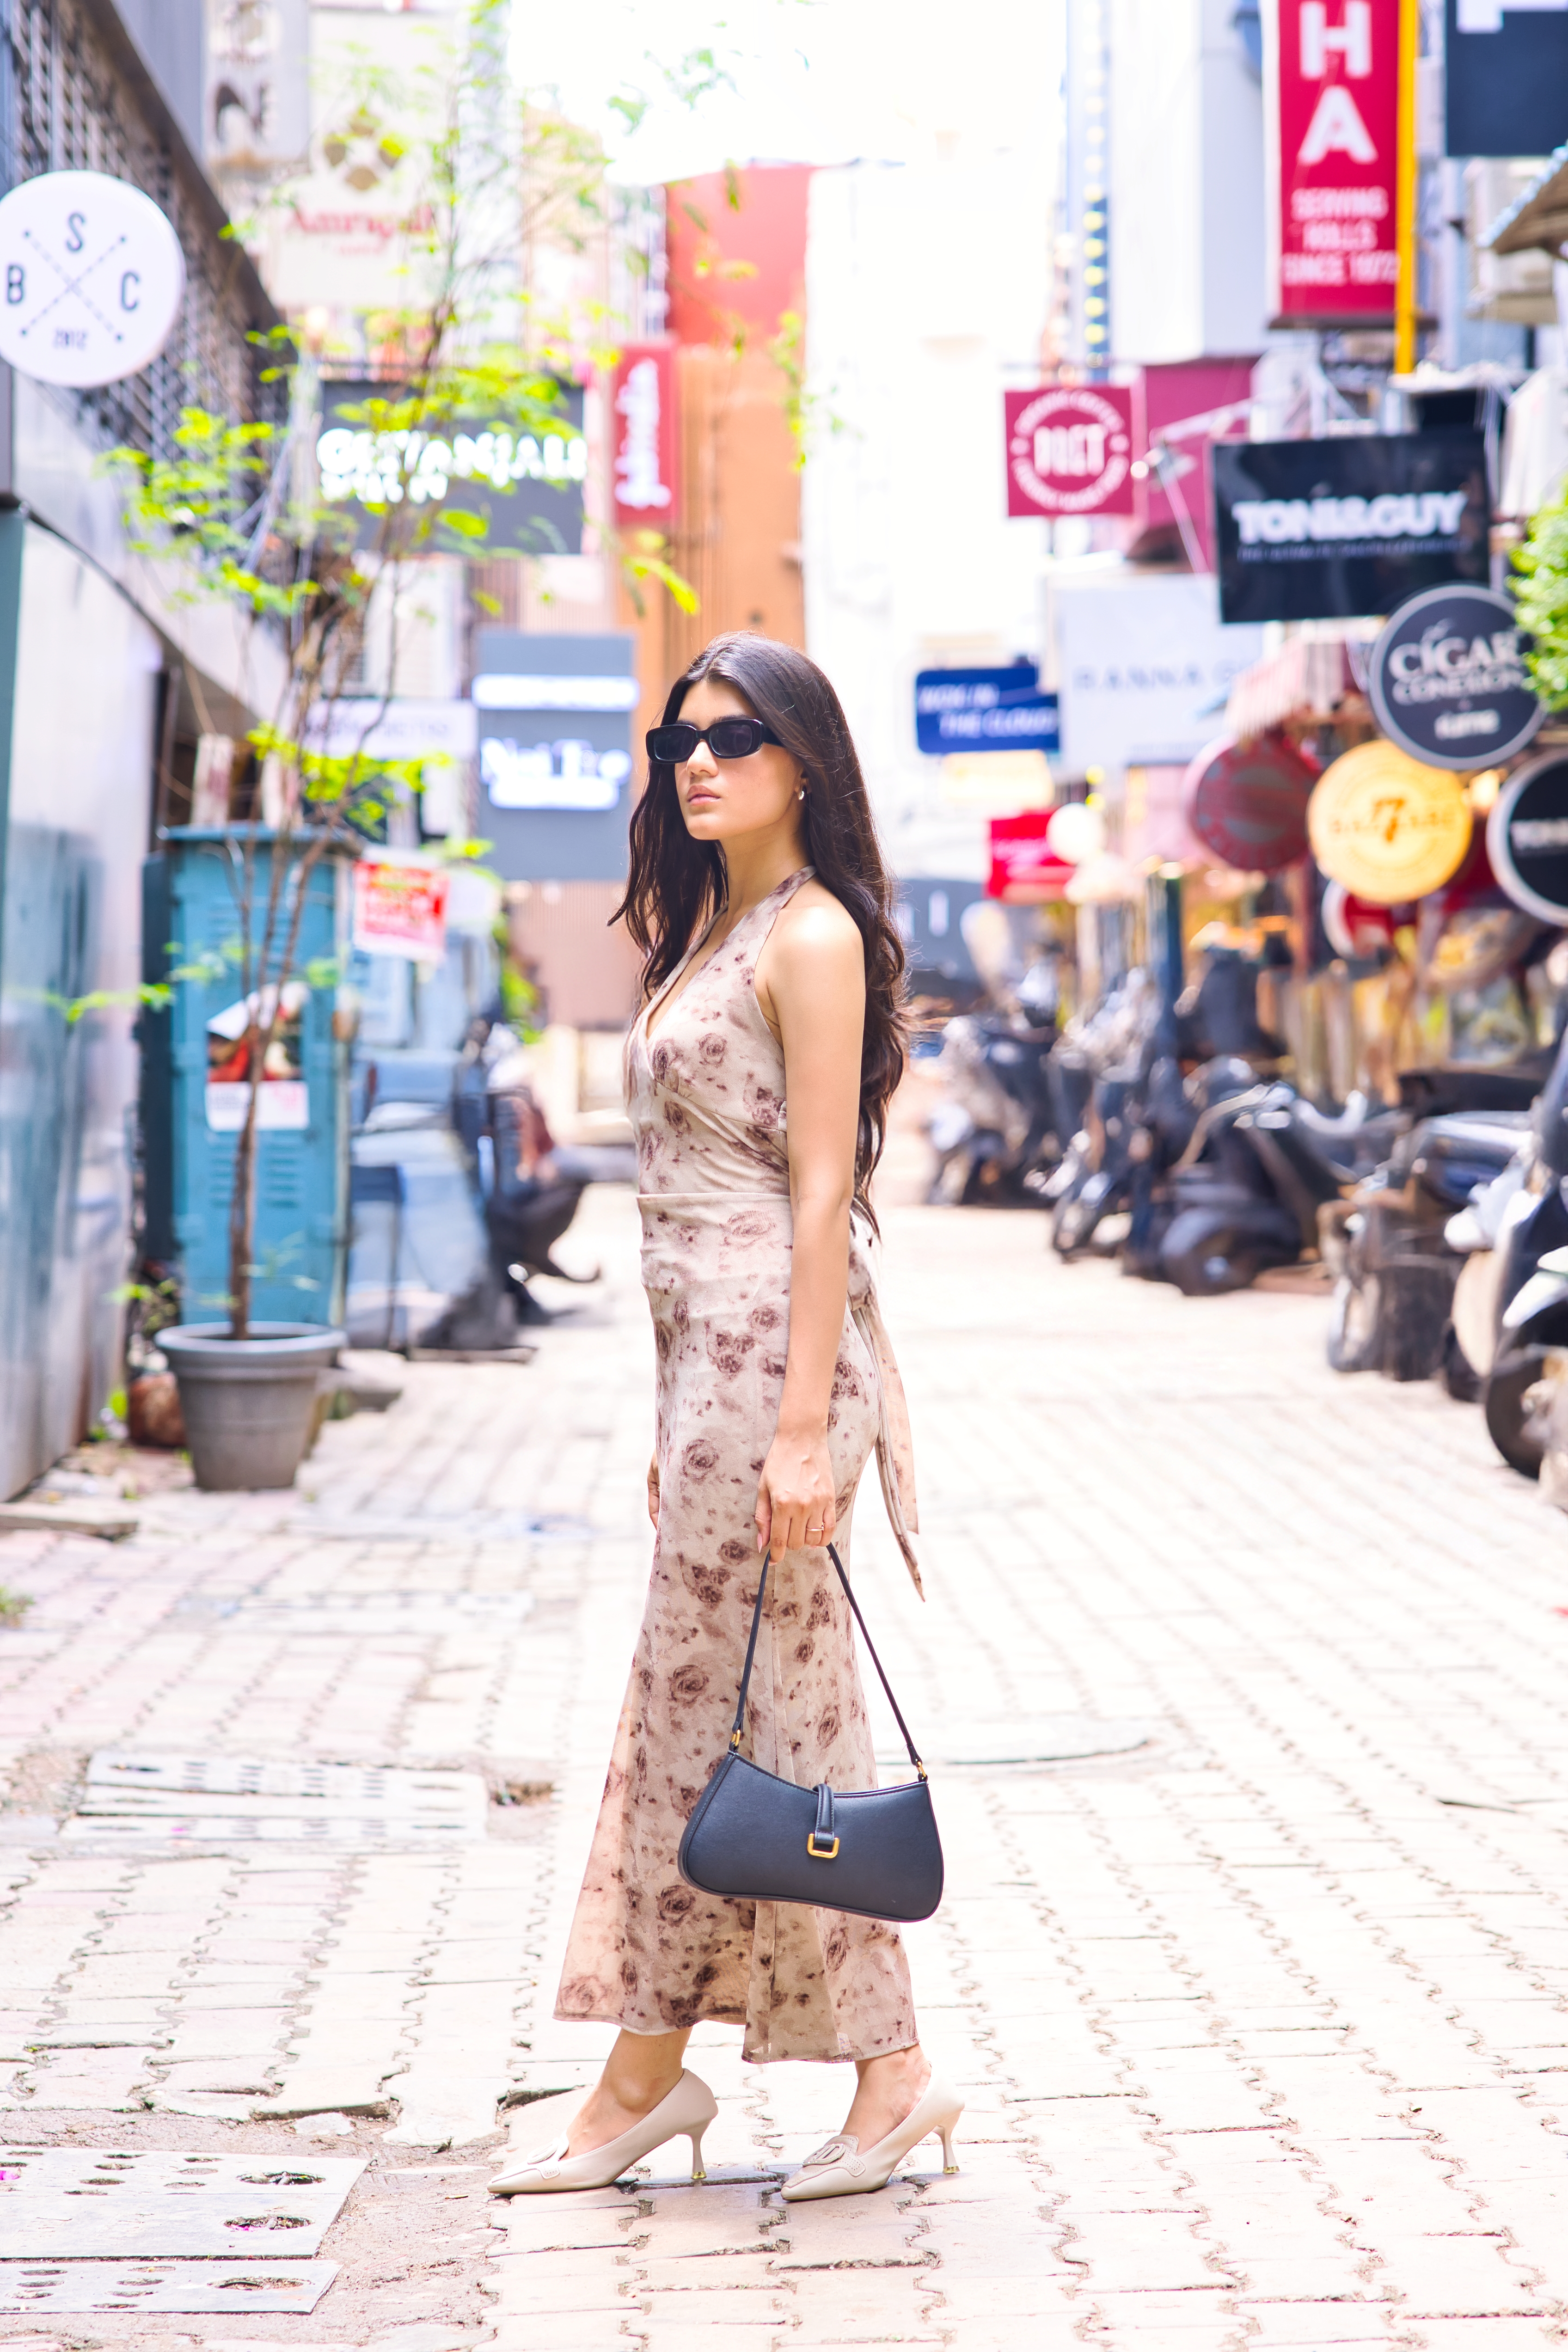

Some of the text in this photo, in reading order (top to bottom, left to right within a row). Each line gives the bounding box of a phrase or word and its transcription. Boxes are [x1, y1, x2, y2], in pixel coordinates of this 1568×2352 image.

[1292, 187, 1388, 220] SERVING
[66, 212, 86, 252] S
[1302, 220, 1378, 251] ROLLS
[1281, 253, 1345, 285] SINCE
[6, 264, 140, 312] B C
[1389, 631, 1522, 680] CIGAR
[938, 710, 982, 739] THE
